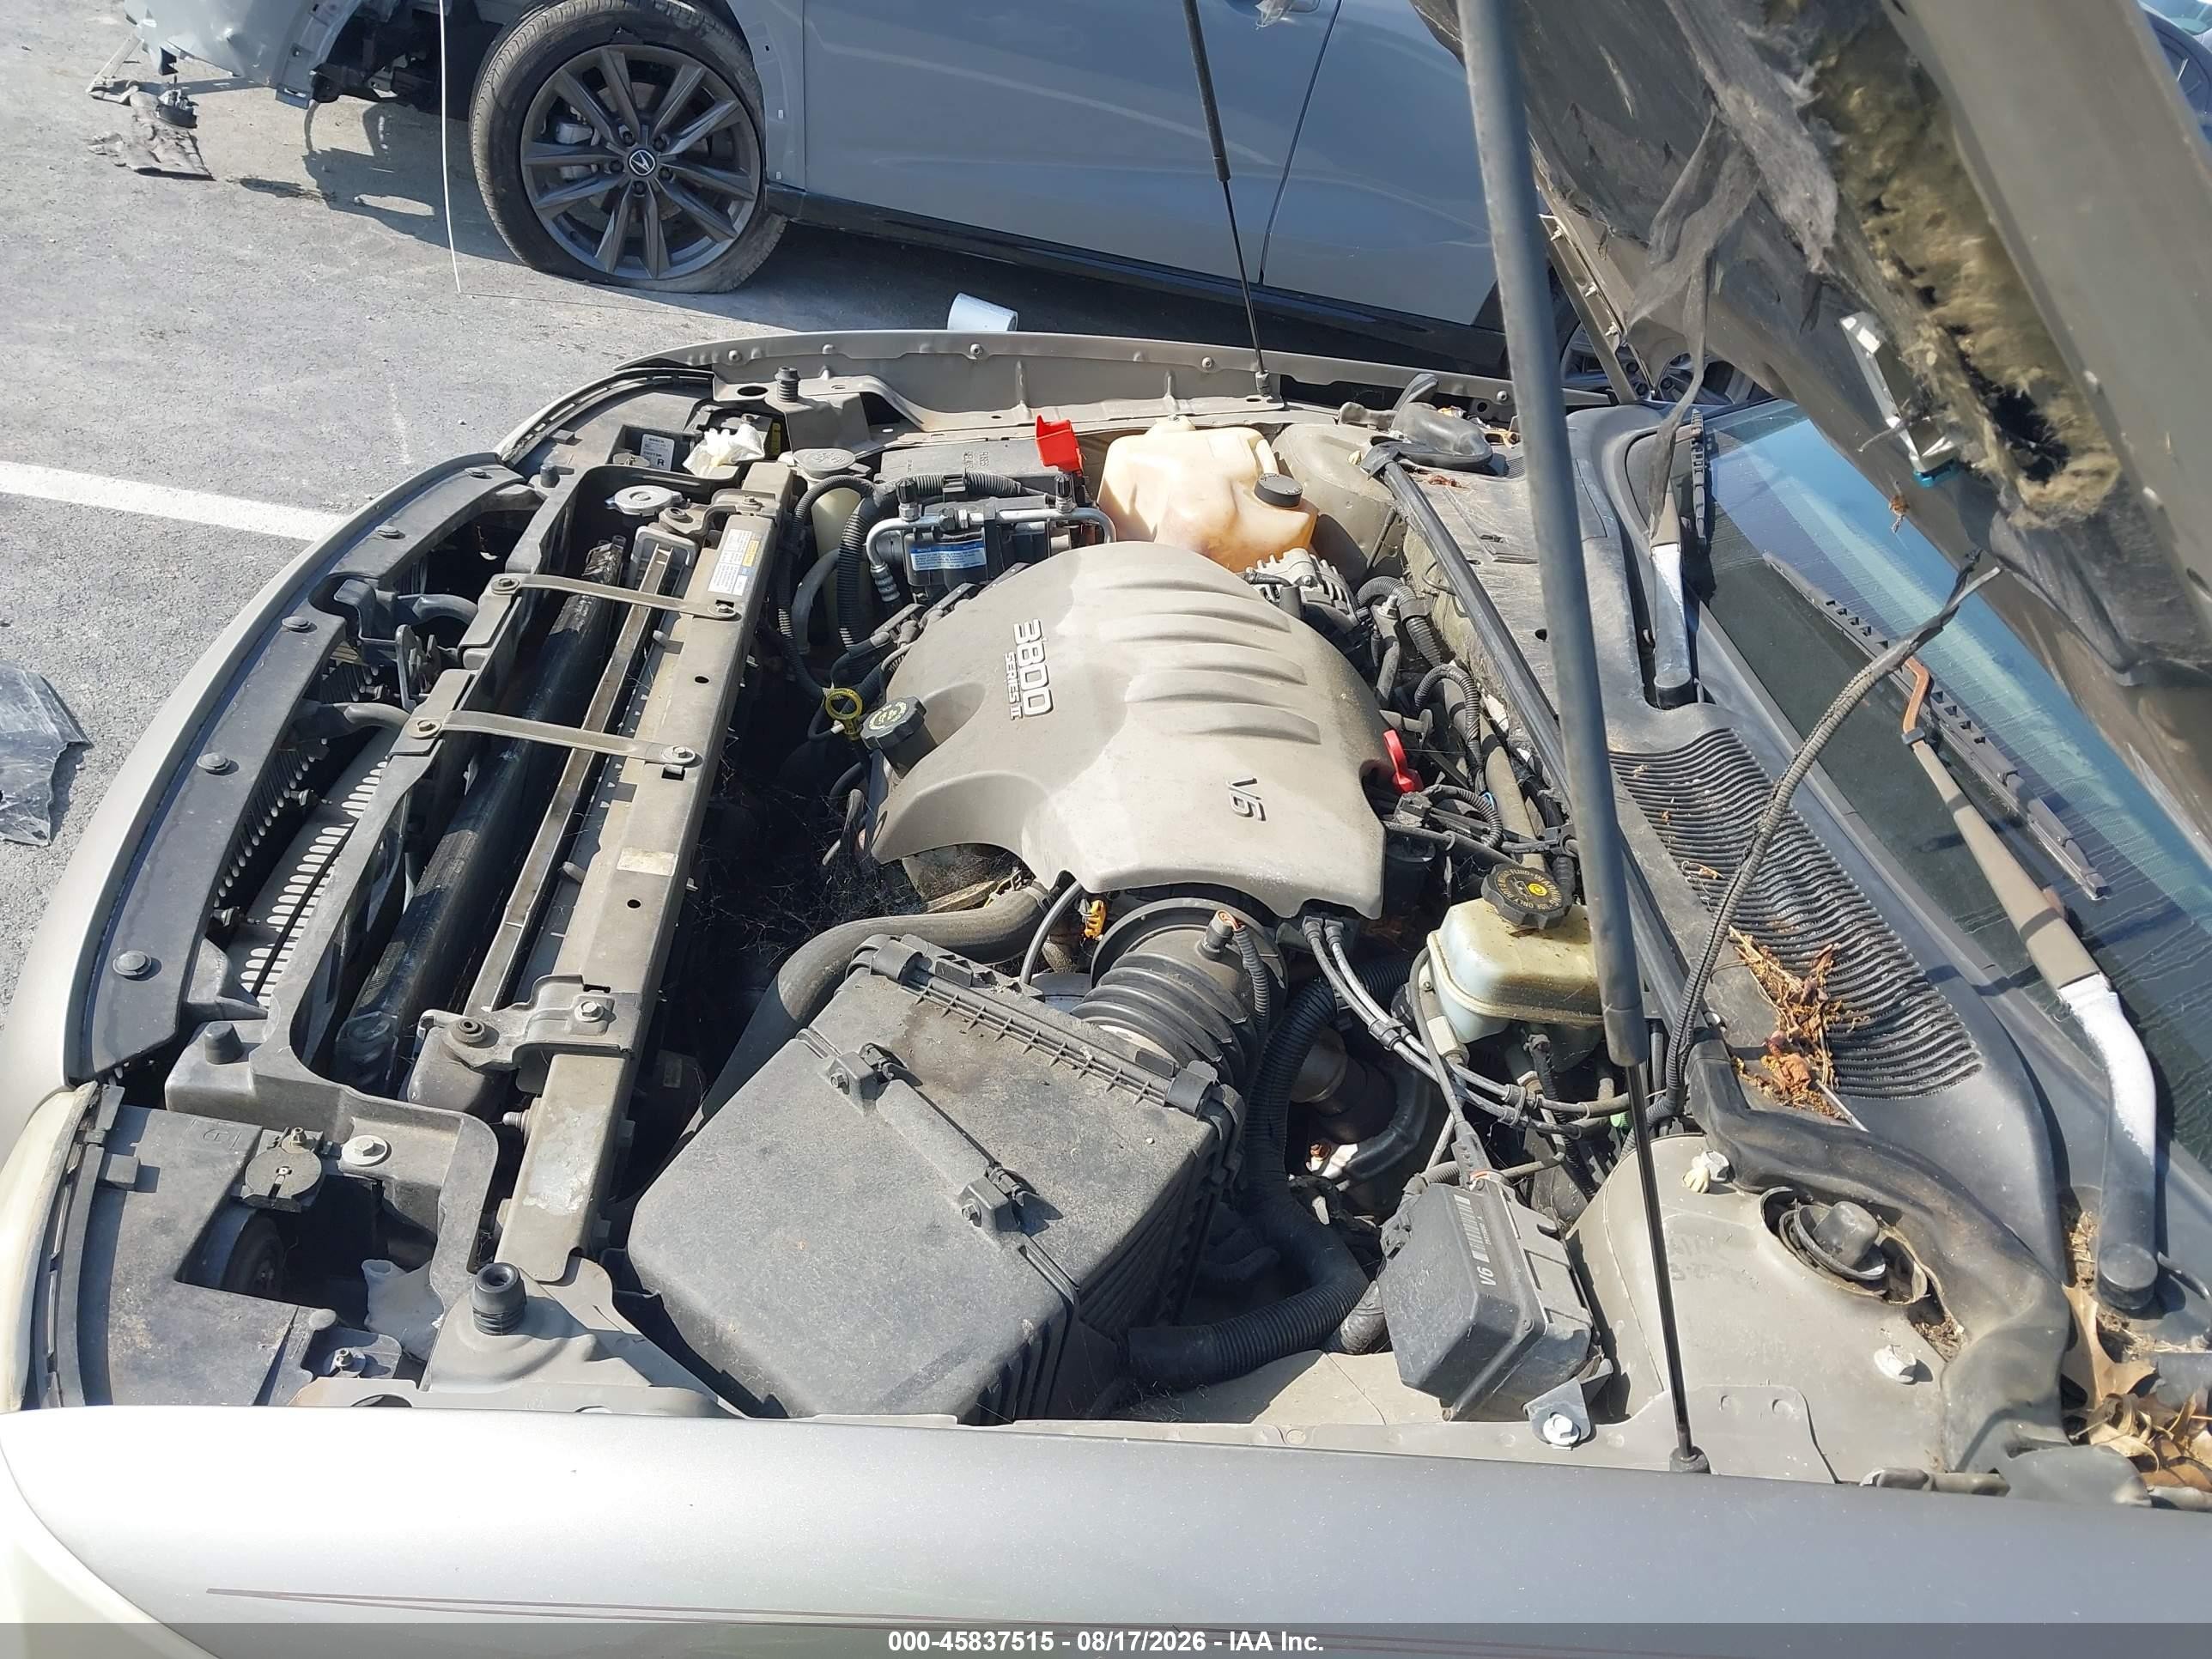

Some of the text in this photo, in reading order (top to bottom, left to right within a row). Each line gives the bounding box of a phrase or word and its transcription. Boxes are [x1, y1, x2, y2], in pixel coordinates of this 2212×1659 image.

[657, 458, 665, 466] R
[1013, 617, 1054, 717] 3800
[1004, 651, 1024, 720] SERIES II
[1225, 777, 1267, 822] V6
[1513, 898, 1534, 908] ONLY
[1534, 873, 1562, 907] WARNING
[1476, 1266, 1497, 1286] V6
